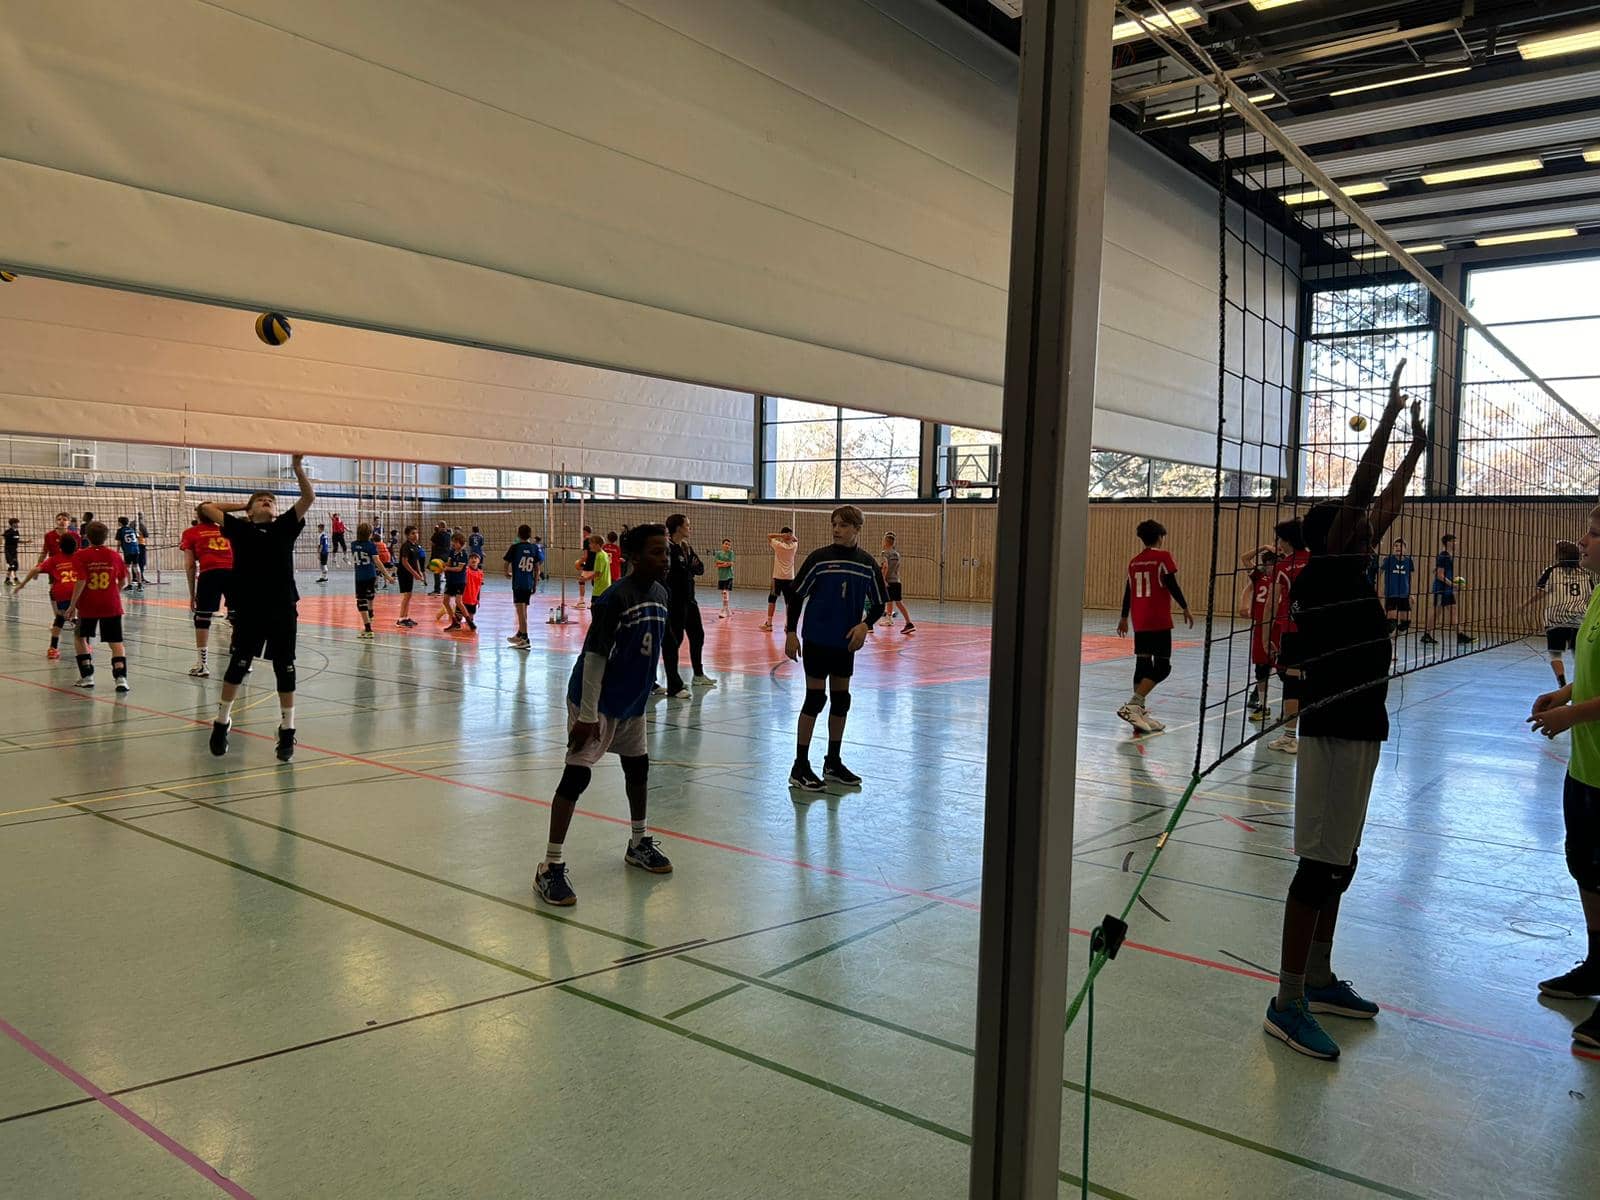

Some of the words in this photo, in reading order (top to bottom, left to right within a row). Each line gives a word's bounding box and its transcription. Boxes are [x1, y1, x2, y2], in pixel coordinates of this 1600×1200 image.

[124, 533, 137, 544] 63
[352, 551, 371, 566] 45
[518, 556, 534, 572] 46
[87, 571, 109, 590] 38
[1134, 571, 1152, 598] 11
[841, 581, 849, 599] 1
[1256, 585, 1268, 603] 2
[640, 632, 653, 657] 9
